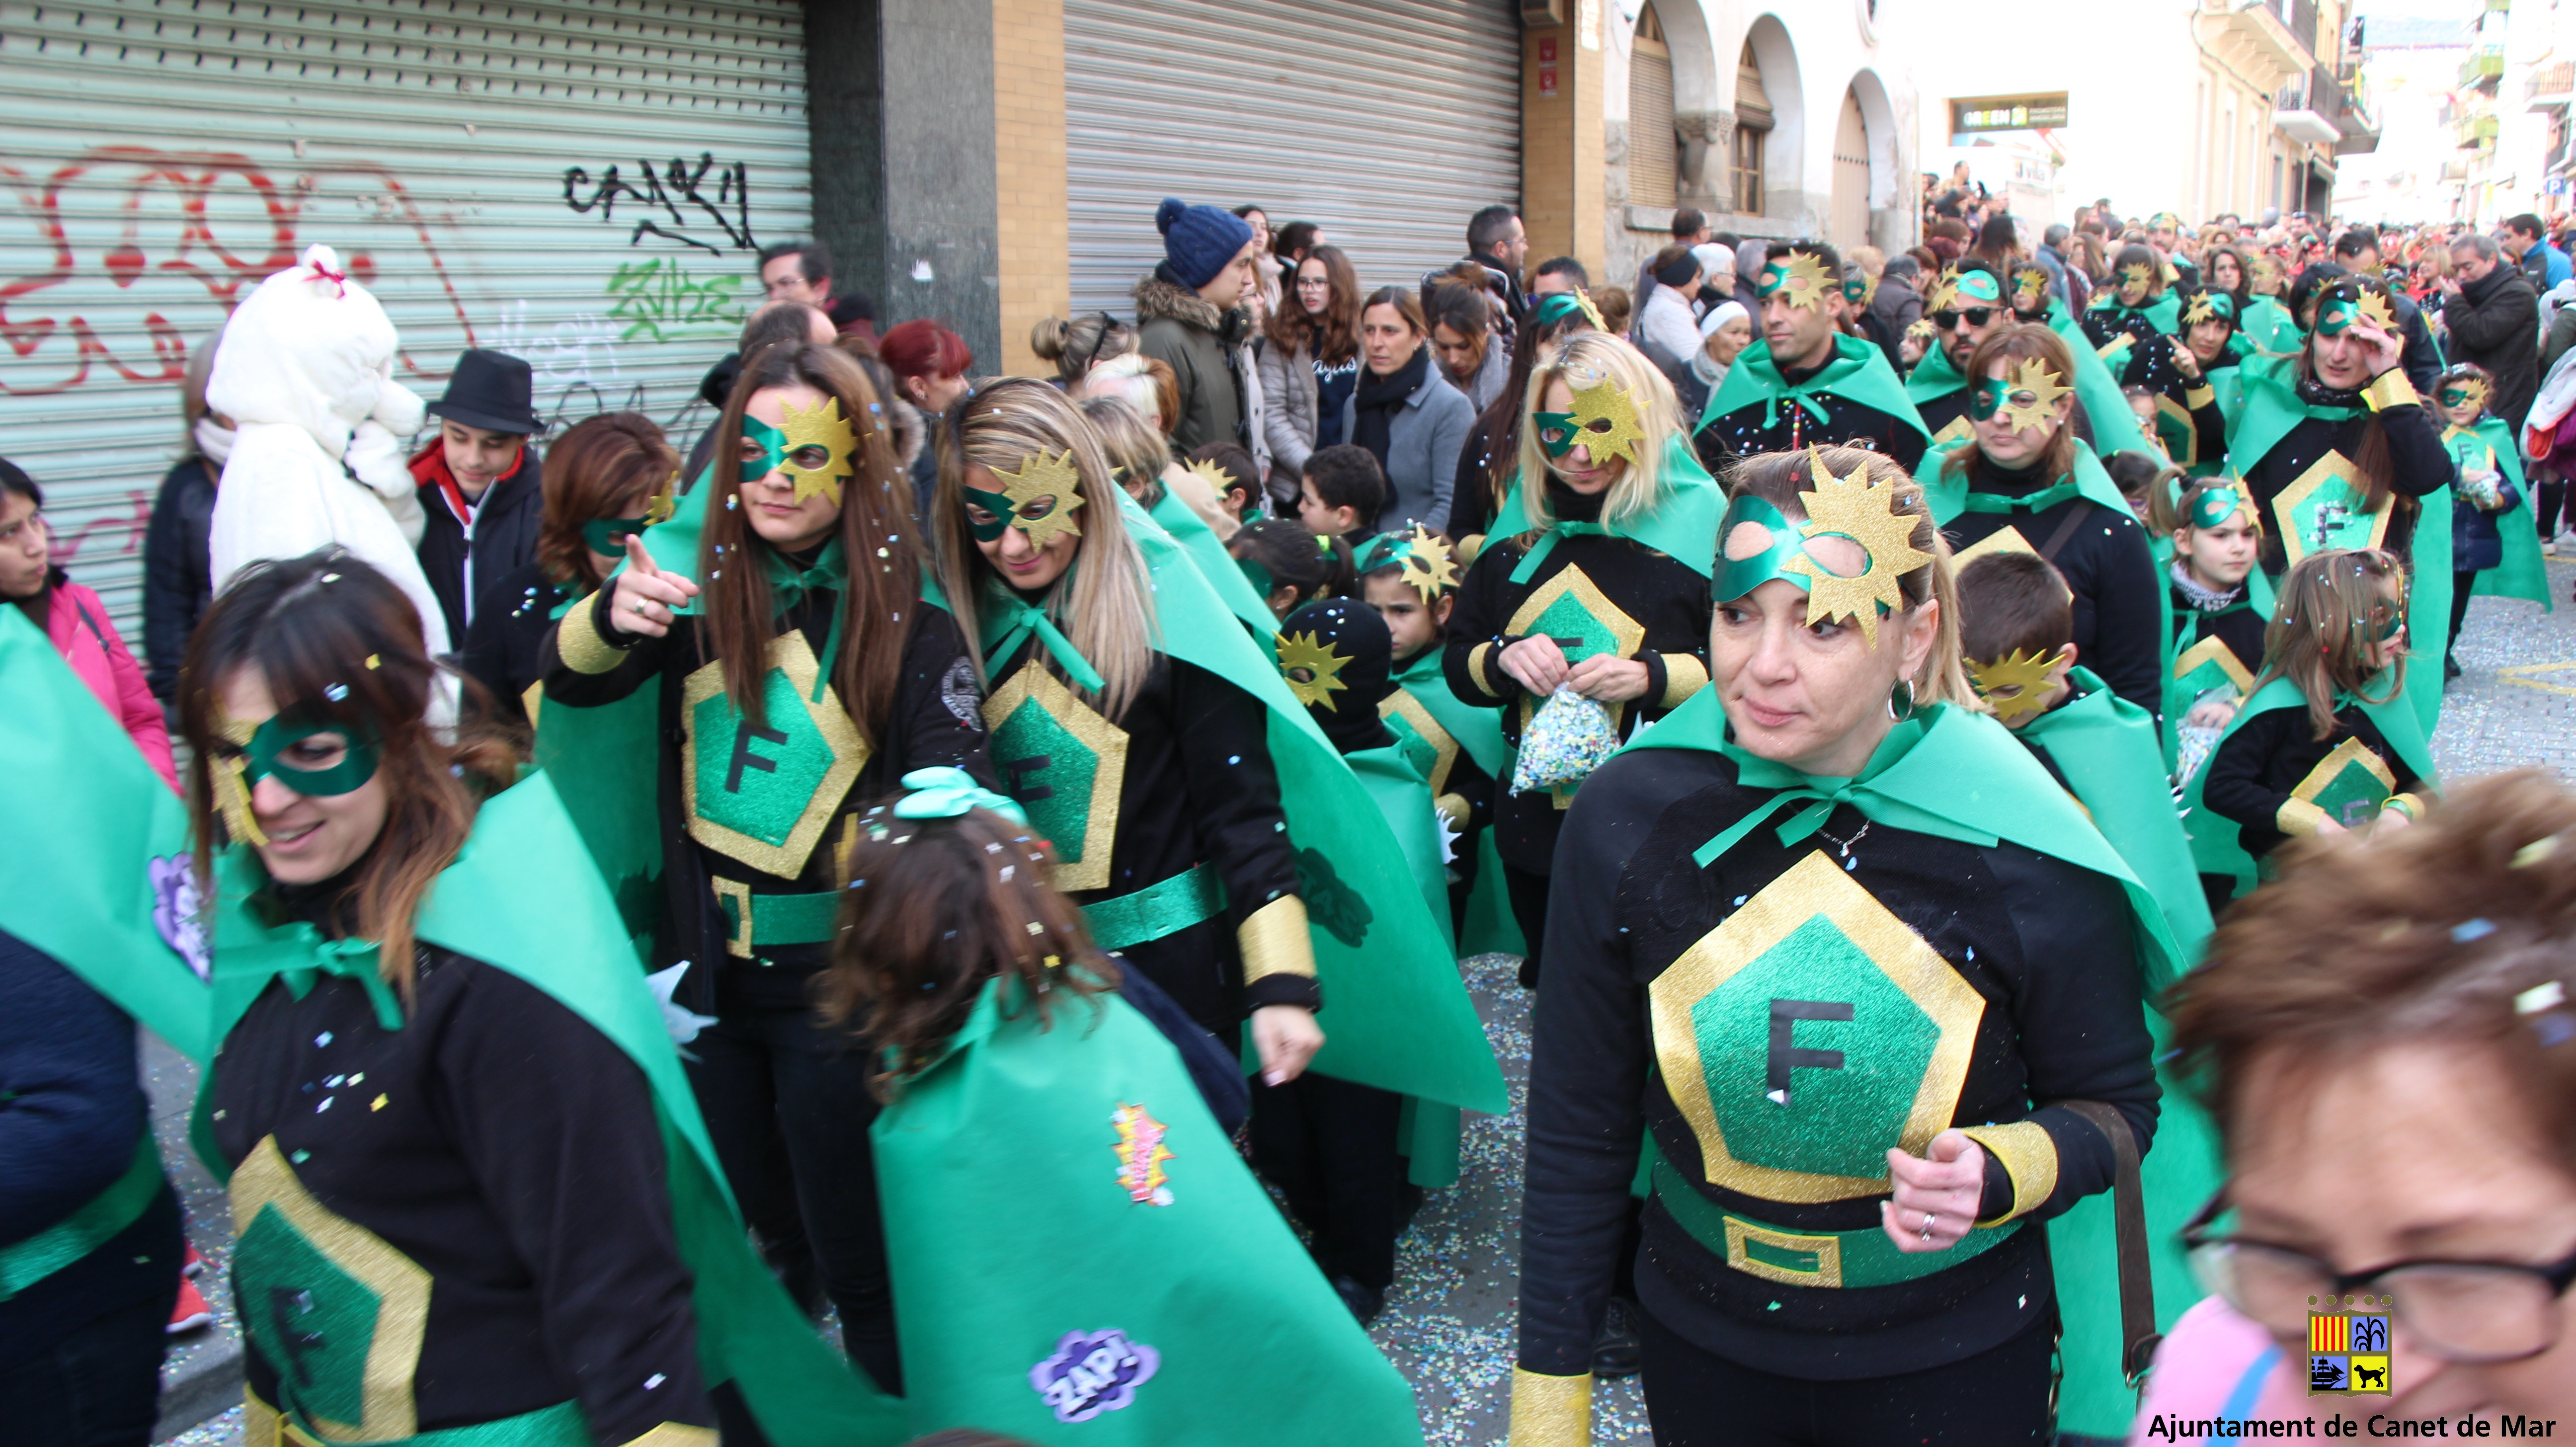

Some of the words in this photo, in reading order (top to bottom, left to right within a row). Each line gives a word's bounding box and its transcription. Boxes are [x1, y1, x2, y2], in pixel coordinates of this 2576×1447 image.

[2549, 180, 2561, 194] P
[2457, 443, 2472, 466] F
[2318, 505, 2348, 546] F
[724, 719, 789, 794] F
[1767, 998, 1854, 1105] F
[270, 1287, 326, 1387] F
[1043, 1336, 1139, 1415] ZAP!
